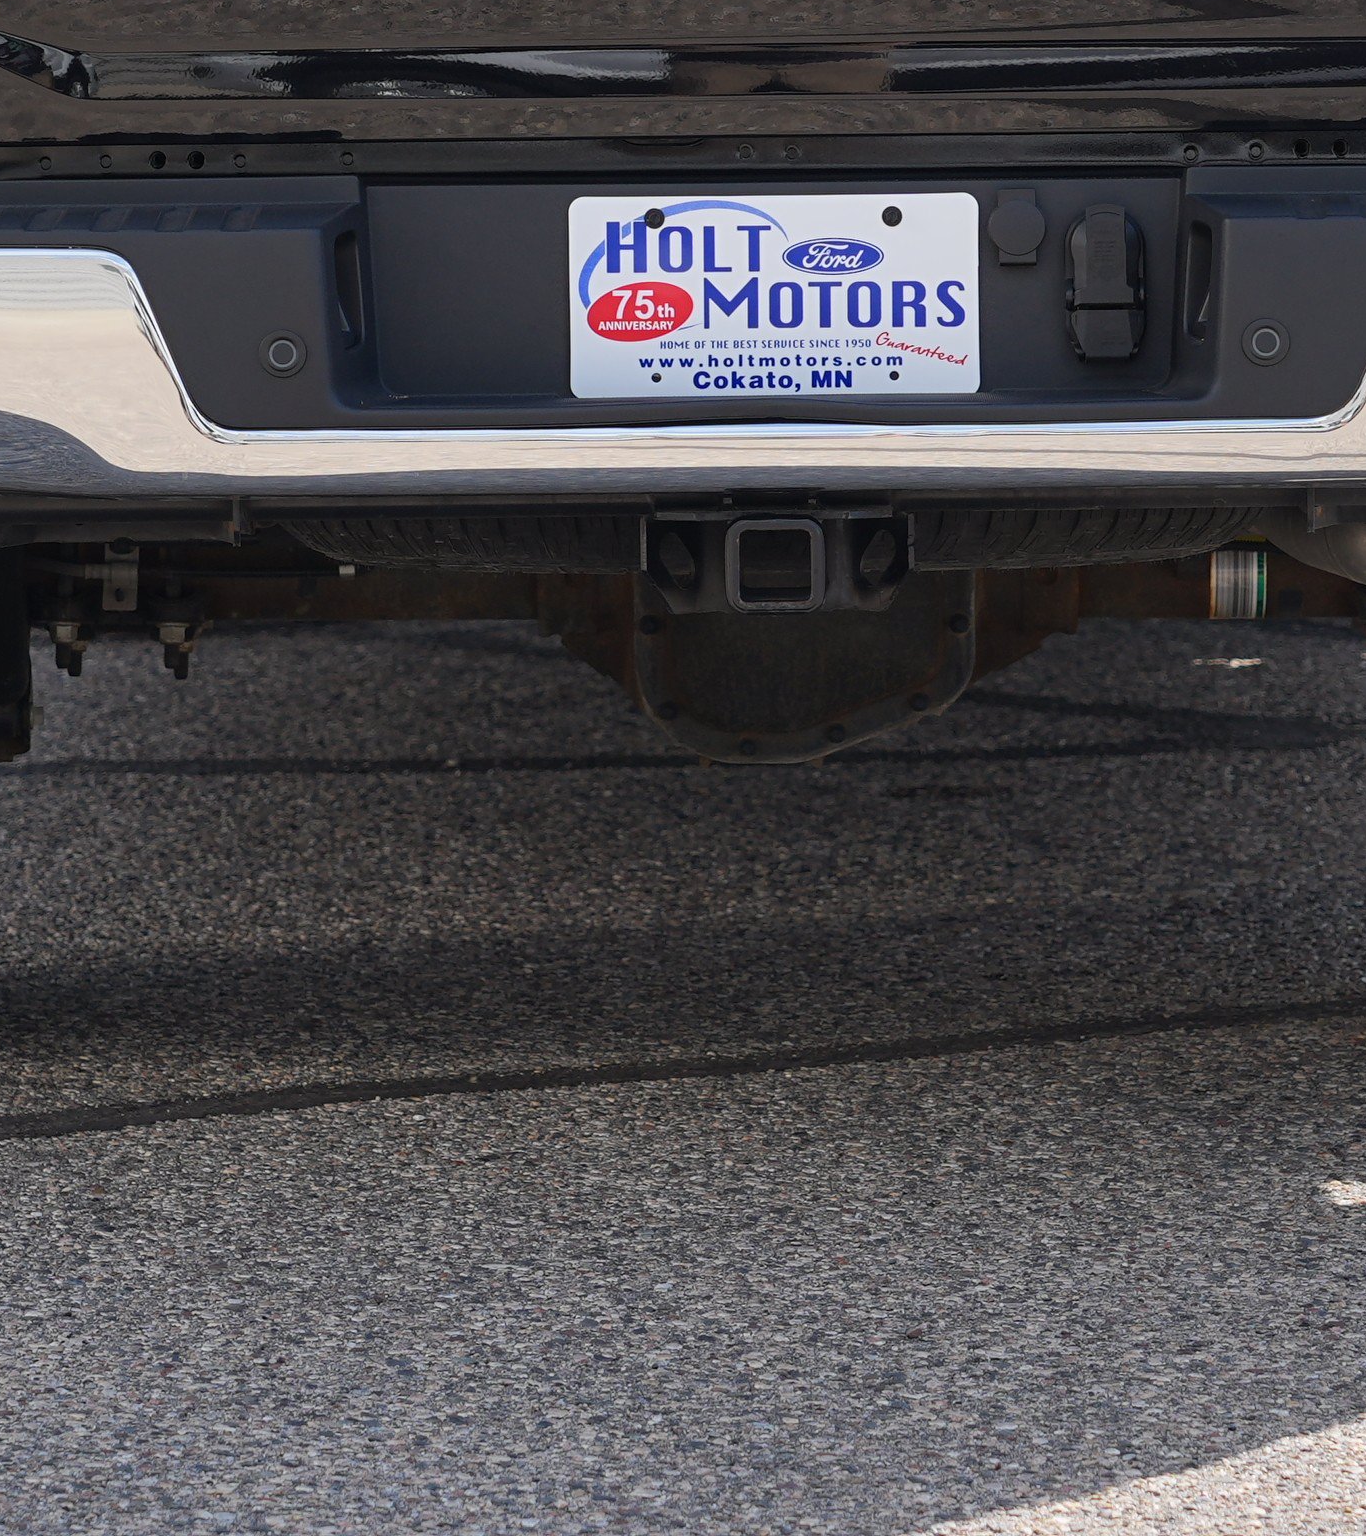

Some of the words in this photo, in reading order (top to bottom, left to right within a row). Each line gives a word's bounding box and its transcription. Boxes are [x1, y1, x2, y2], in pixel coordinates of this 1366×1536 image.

[606, 221, 771, 273] HOLT
[802, 241, 863, 269] Ford
[611, 289, 675, 320] 75th
[703, 277, 966, 329] MOTORS
[598, 320, 674, 331] ANNIVERSARY
[660, 340, 690, 350] HOME
[694, 340, 706, 349] OF
[711, 340, 729, 349] THE
[733, 340, 758, 349] BEST
[761, 339, 805, 349] SERVICE
[809, 339, 840, 348] SINCE
[845, 339, 871, 348] 1950
[875, 331, 969, 366] Guaranteed
[639, 354, 903, 368] www.holtmotors.com
[693, 370, 801, 392] Cokato,
[811, 370, 852, 388] MN
